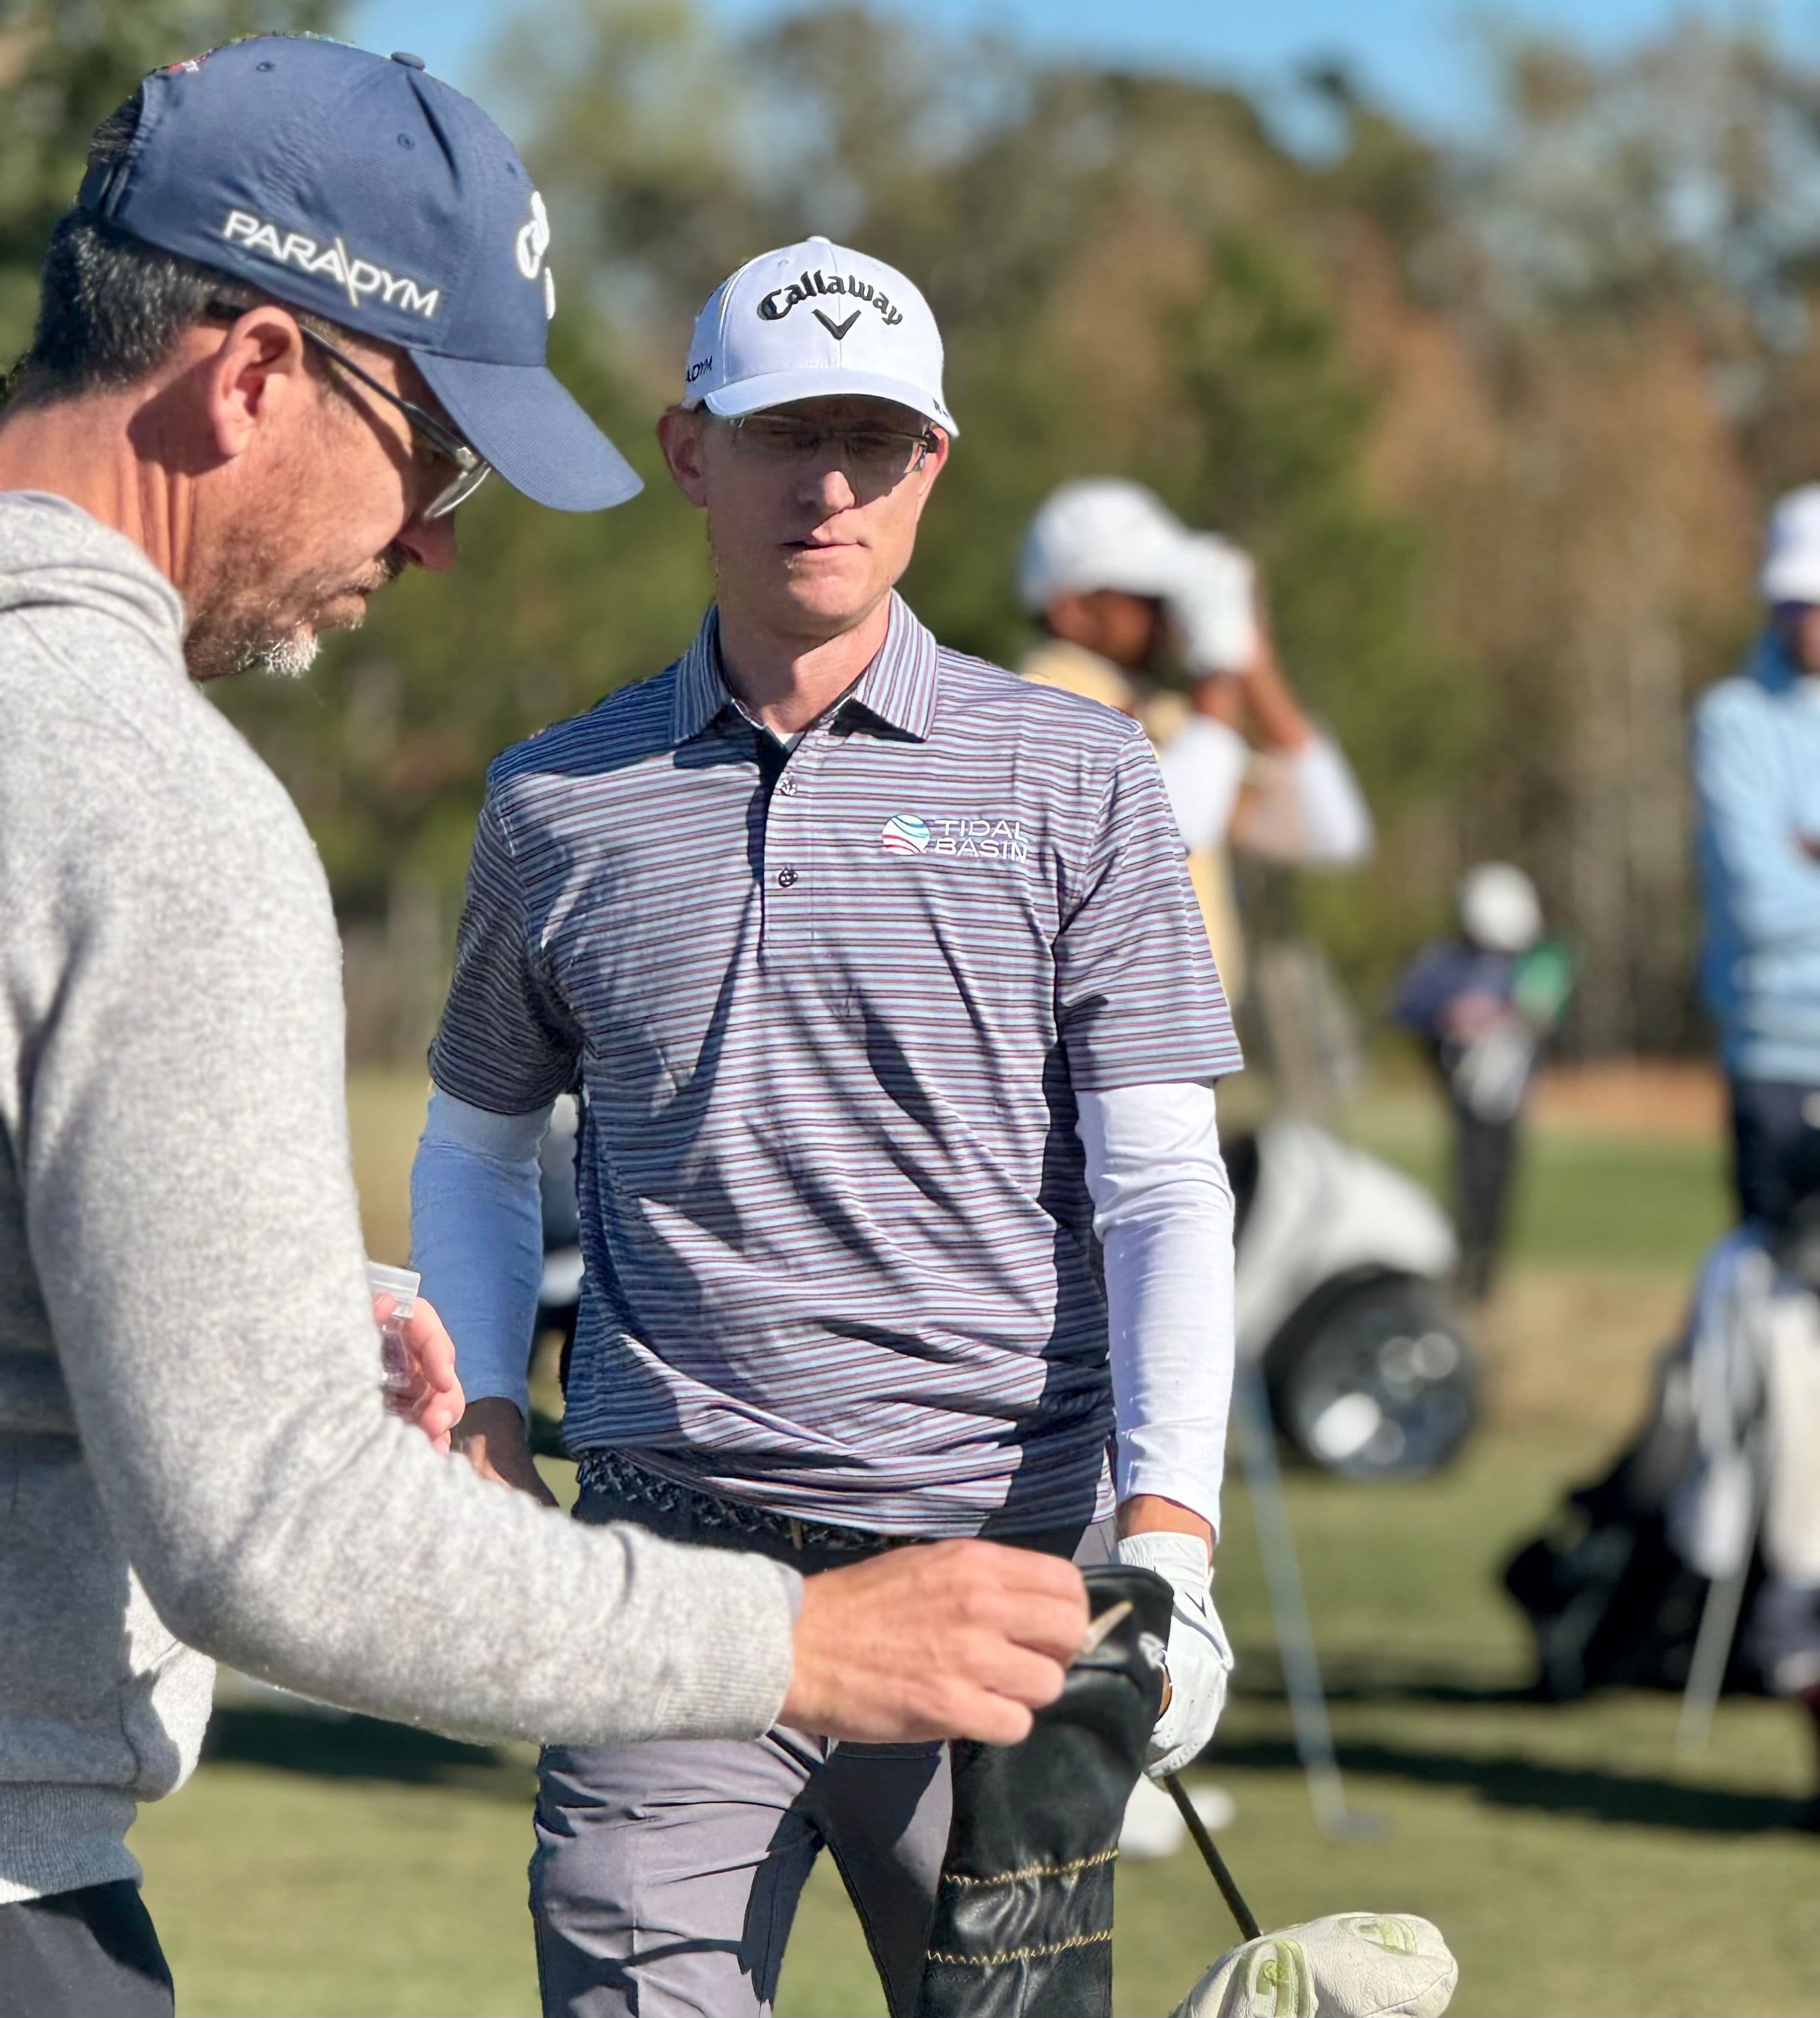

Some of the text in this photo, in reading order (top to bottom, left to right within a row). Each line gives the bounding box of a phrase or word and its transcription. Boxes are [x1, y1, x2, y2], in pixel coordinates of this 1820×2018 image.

[223, 211, 439, 317] PARADYM
[757, 270, 903, 326] Callaway
[934, 819, 1029, 844] TIDAL
[934, 837, 1029, 864] BASIN
